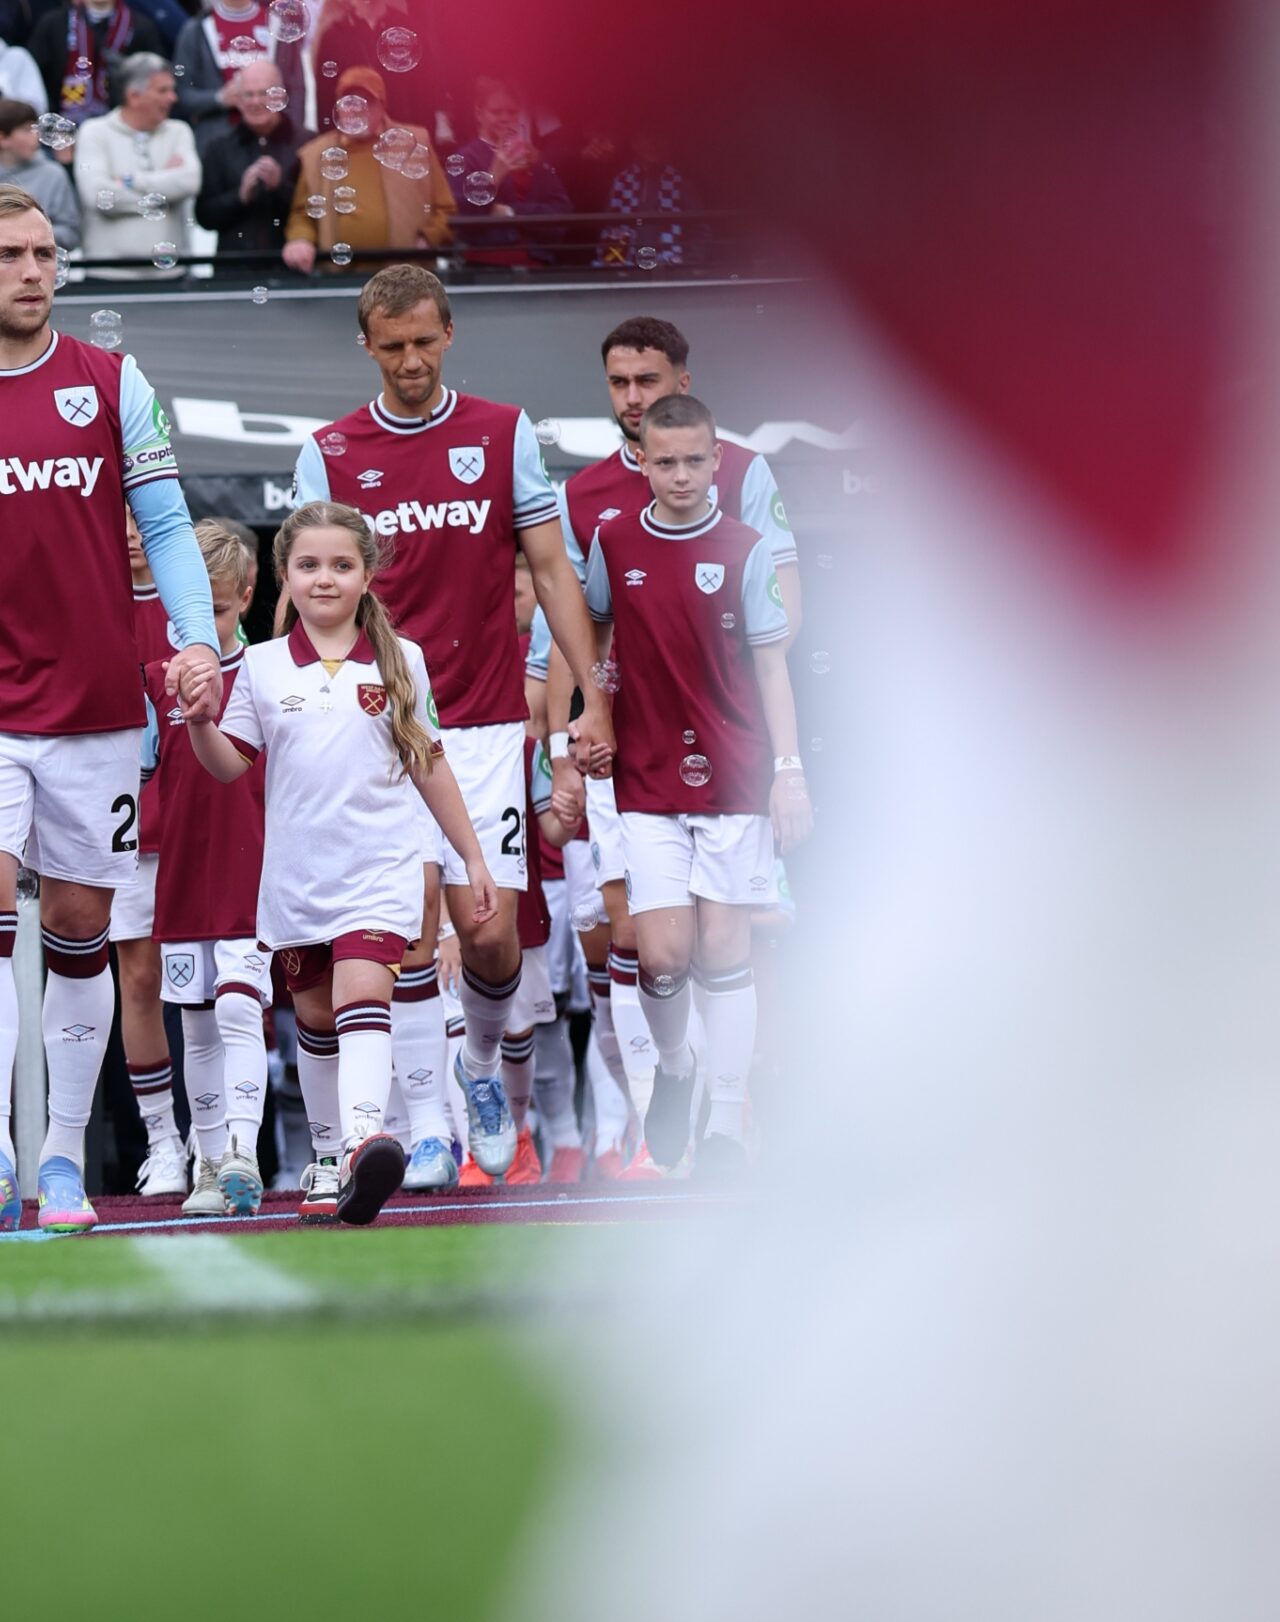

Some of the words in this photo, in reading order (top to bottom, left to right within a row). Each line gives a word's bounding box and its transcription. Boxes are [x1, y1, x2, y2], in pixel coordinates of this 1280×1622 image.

[136, 446, 173, 464] Capt
[501, 806, 526, 857] 2
[363, 934, 384, 943] umbro
